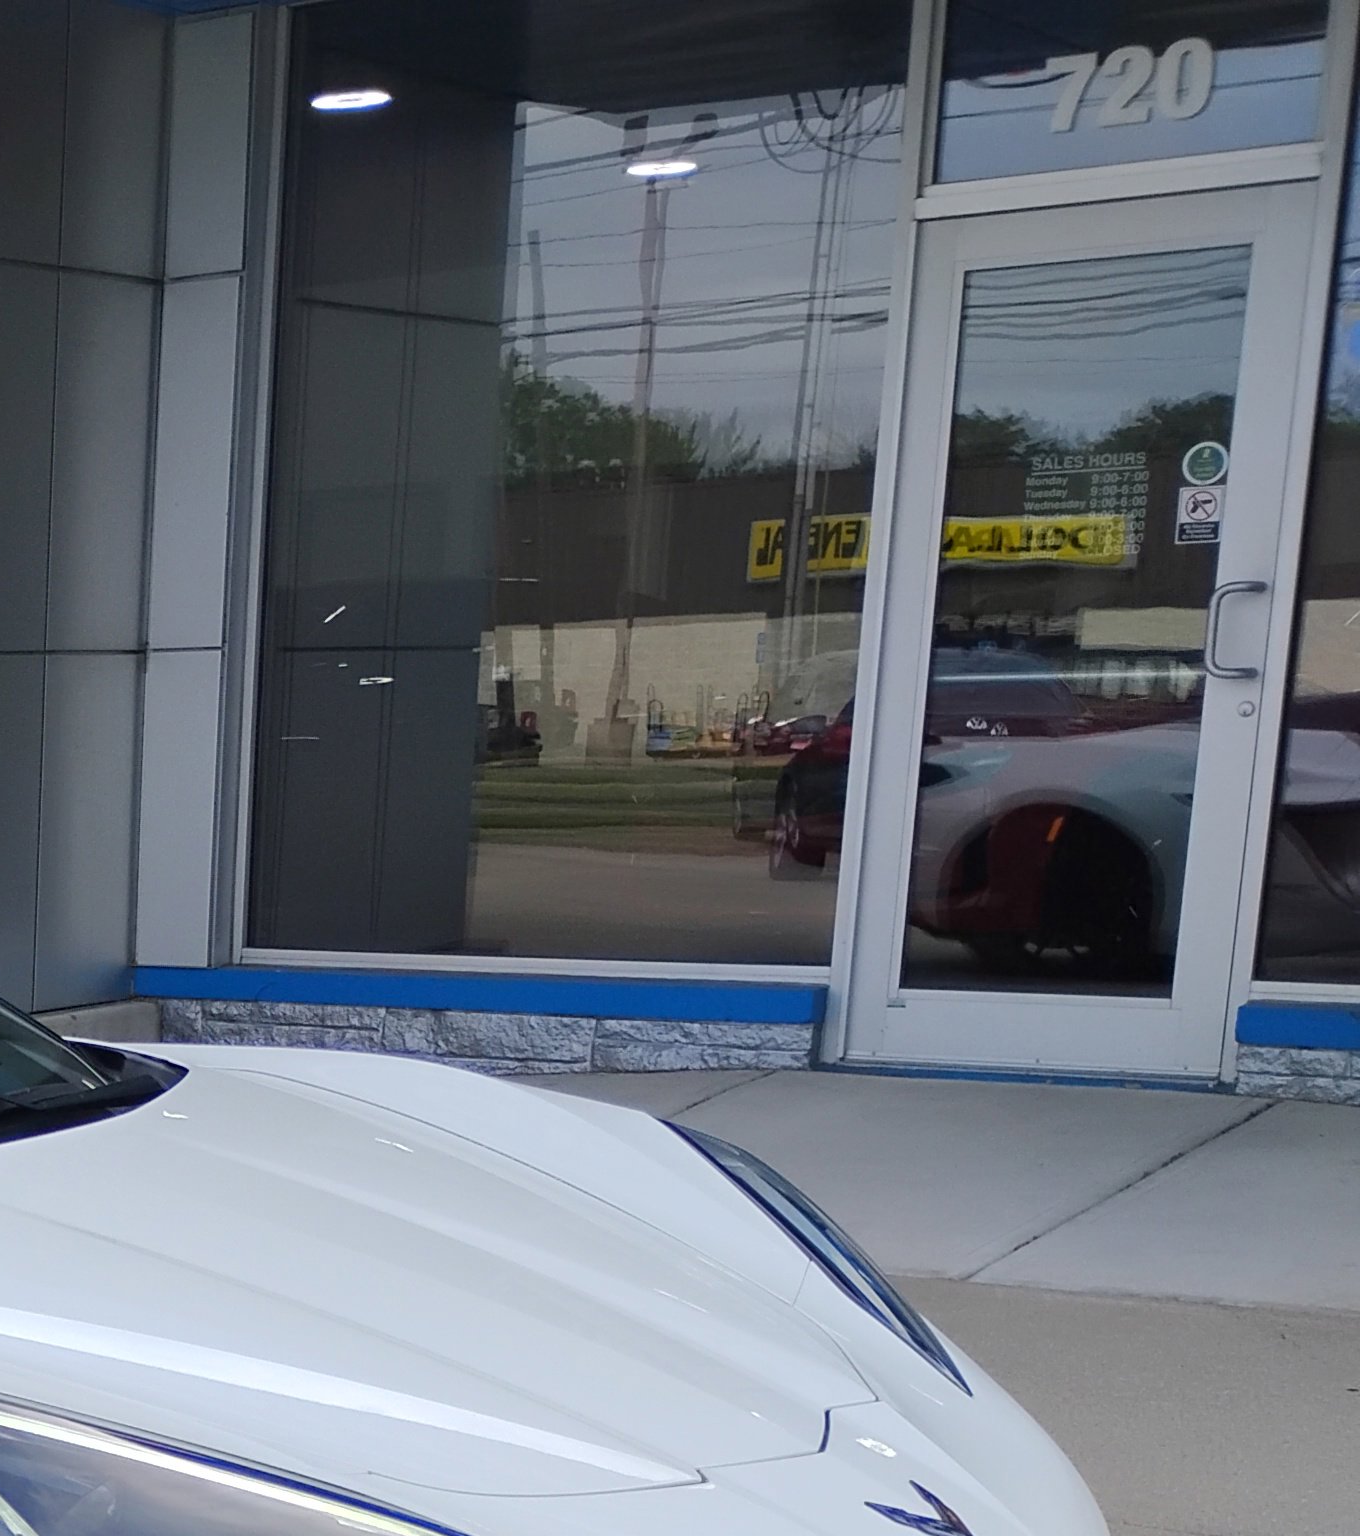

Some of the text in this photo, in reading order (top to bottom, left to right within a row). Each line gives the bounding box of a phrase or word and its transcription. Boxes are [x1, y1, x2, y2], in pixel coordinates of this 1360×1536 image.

[1046, 37, 1214, 132] 720
[1032, 452, 1147, 471] SALES HOURS
[1025, 471, 1150, 487] Monday 9:00-7:00
[1025, 489, 1068, 499] Tuesday
[1024, 501, 1086, 512] Wednesday
